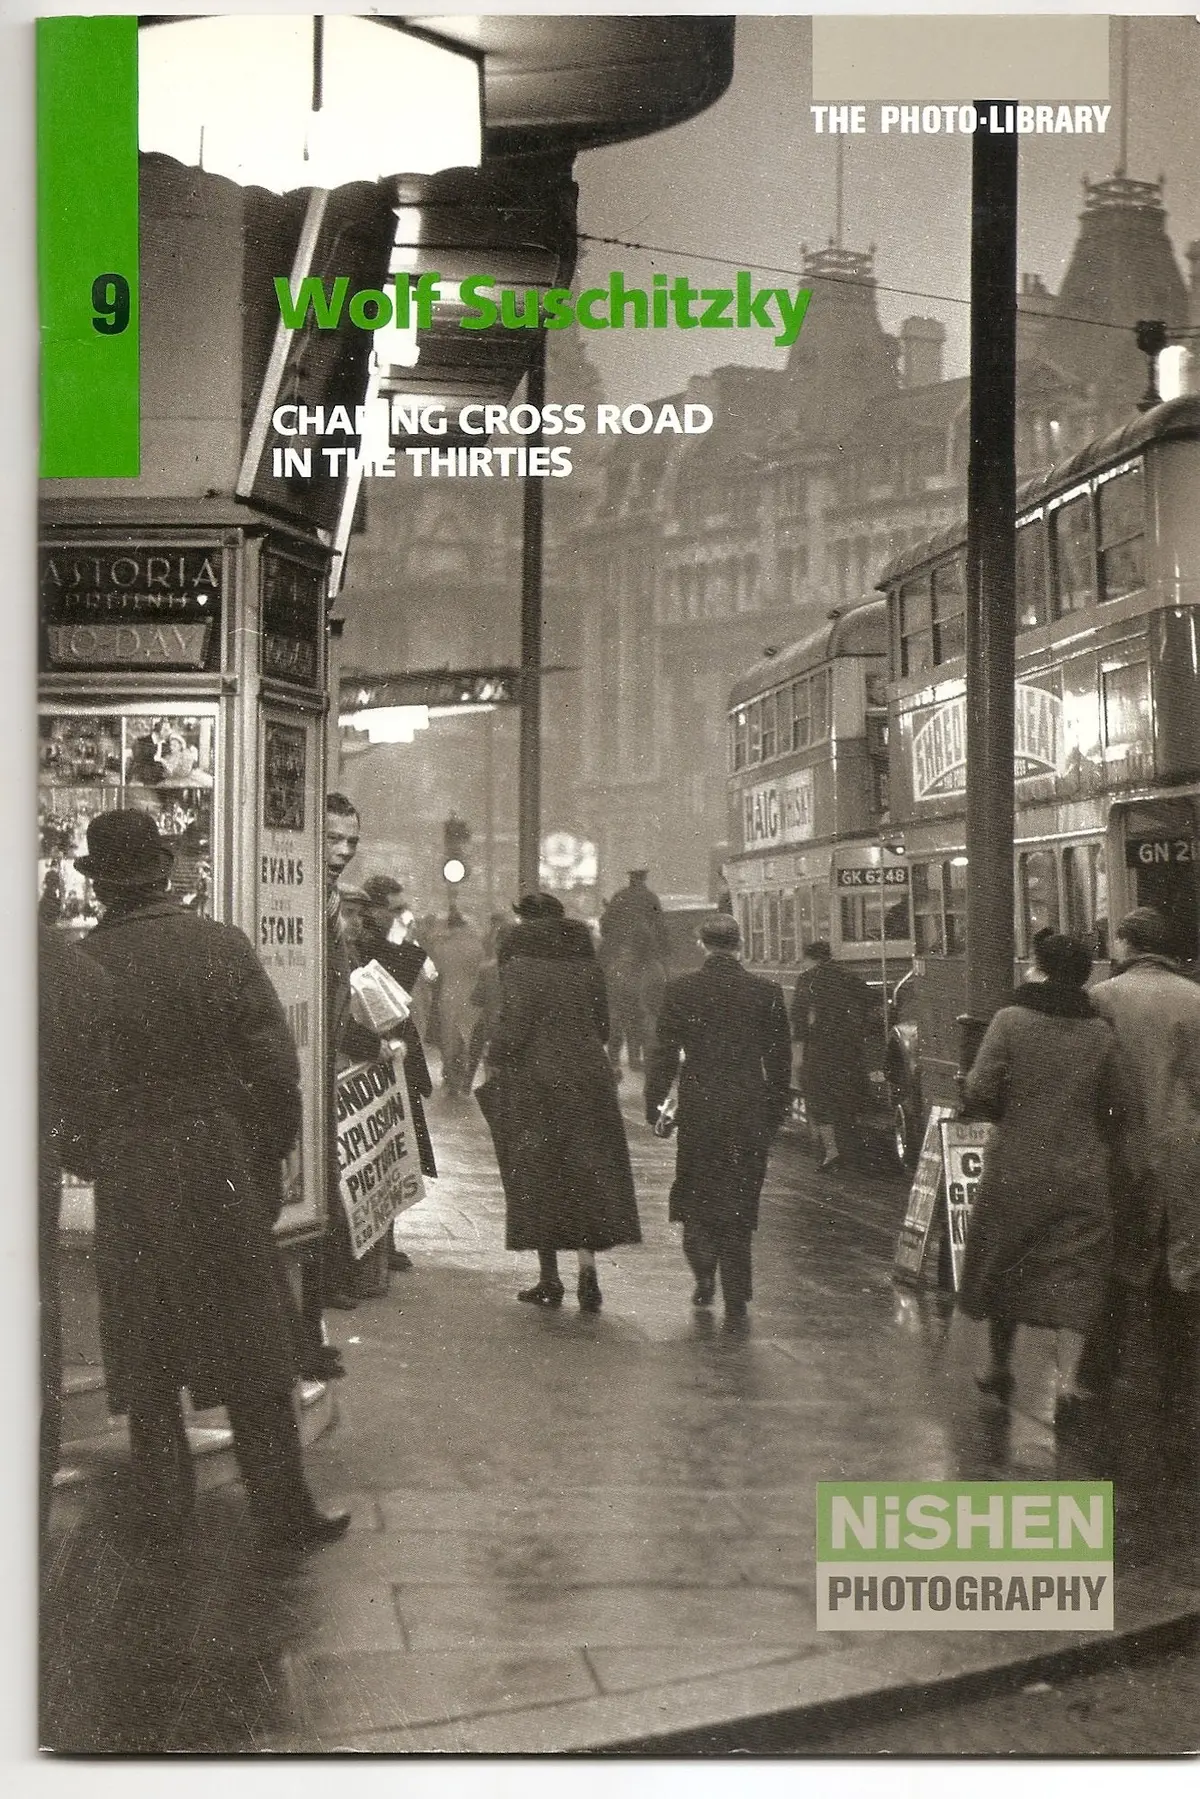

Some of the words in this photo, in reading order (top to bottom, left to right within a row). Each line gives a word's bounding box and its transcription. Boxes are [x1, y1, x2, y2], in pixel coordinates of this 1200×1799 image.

[42, 556, 218, 588] ASTORIA
[745, 787, 779, 841] HAIG
[1139, 842, 1170, 864] GN
[261, 855, 304, 886] EVANS
[841, 868, 862, 885] GK
[864, 867, 905, 885] 6248
[261, 915, 304, 945] STONE
